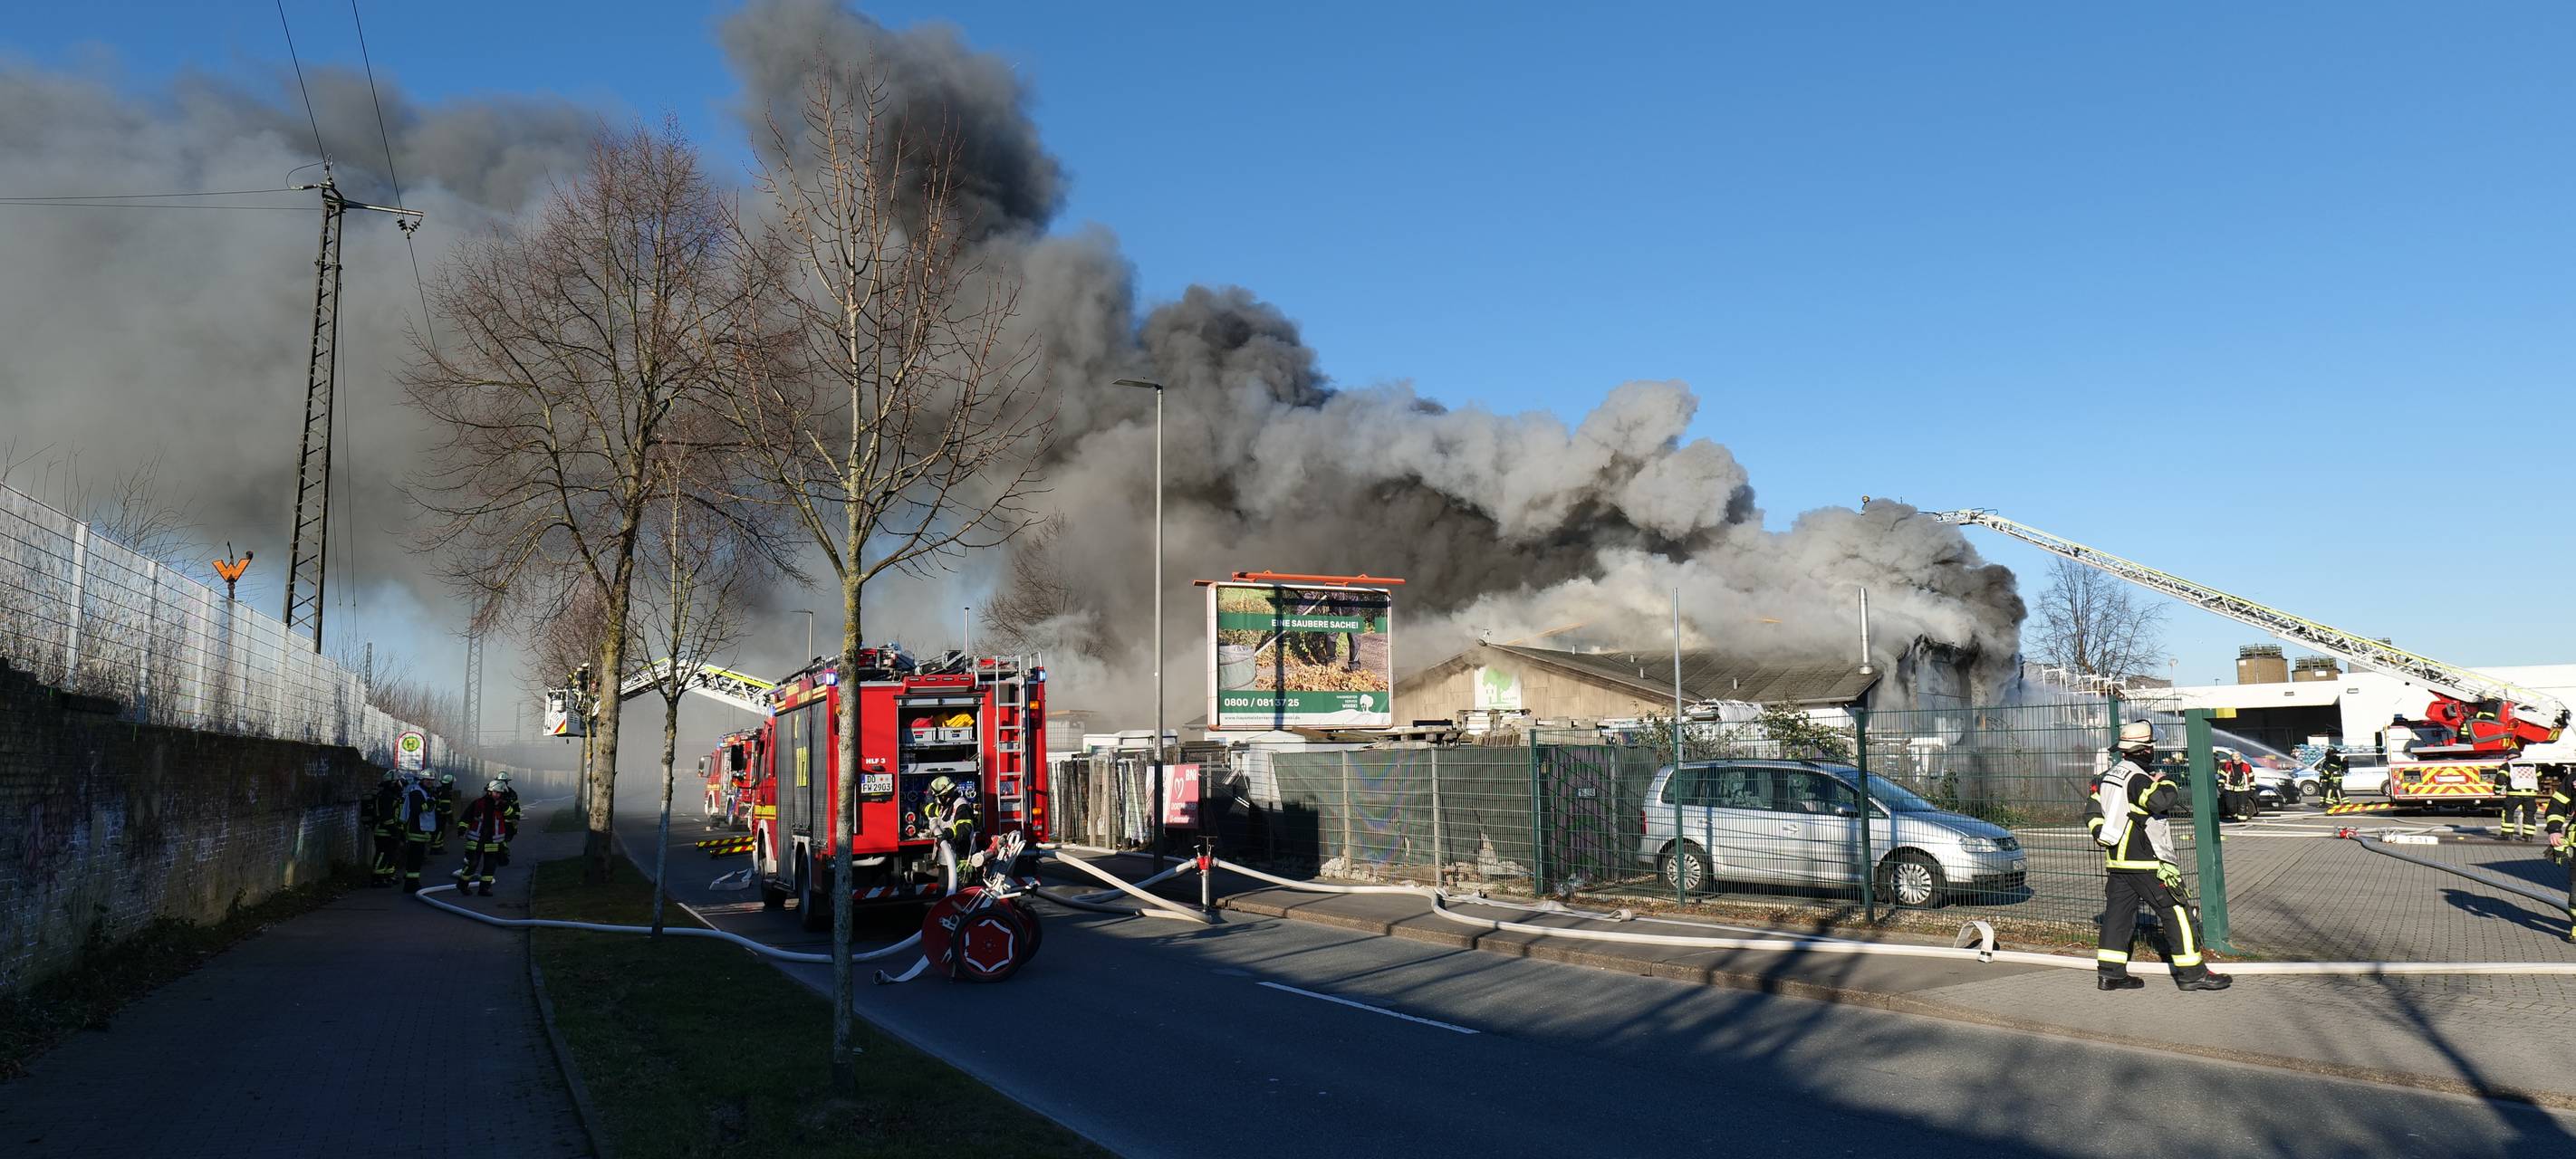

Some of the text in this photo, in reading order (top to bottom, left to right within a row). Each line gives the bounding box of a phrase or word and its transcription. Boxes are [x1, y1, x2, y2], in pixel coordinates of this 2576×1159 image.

[1292, 619, 1329, 628] SAUBERE
[1224, 698, 1248, 707] 0800
[1256, 698, 1274, 707] 081
[1288, 698, 1300, 707] 25
[797, 747, 807, 787] 112
[867, 775, 876, 783] DO
[863, 782, 890, 792] FW 2903
